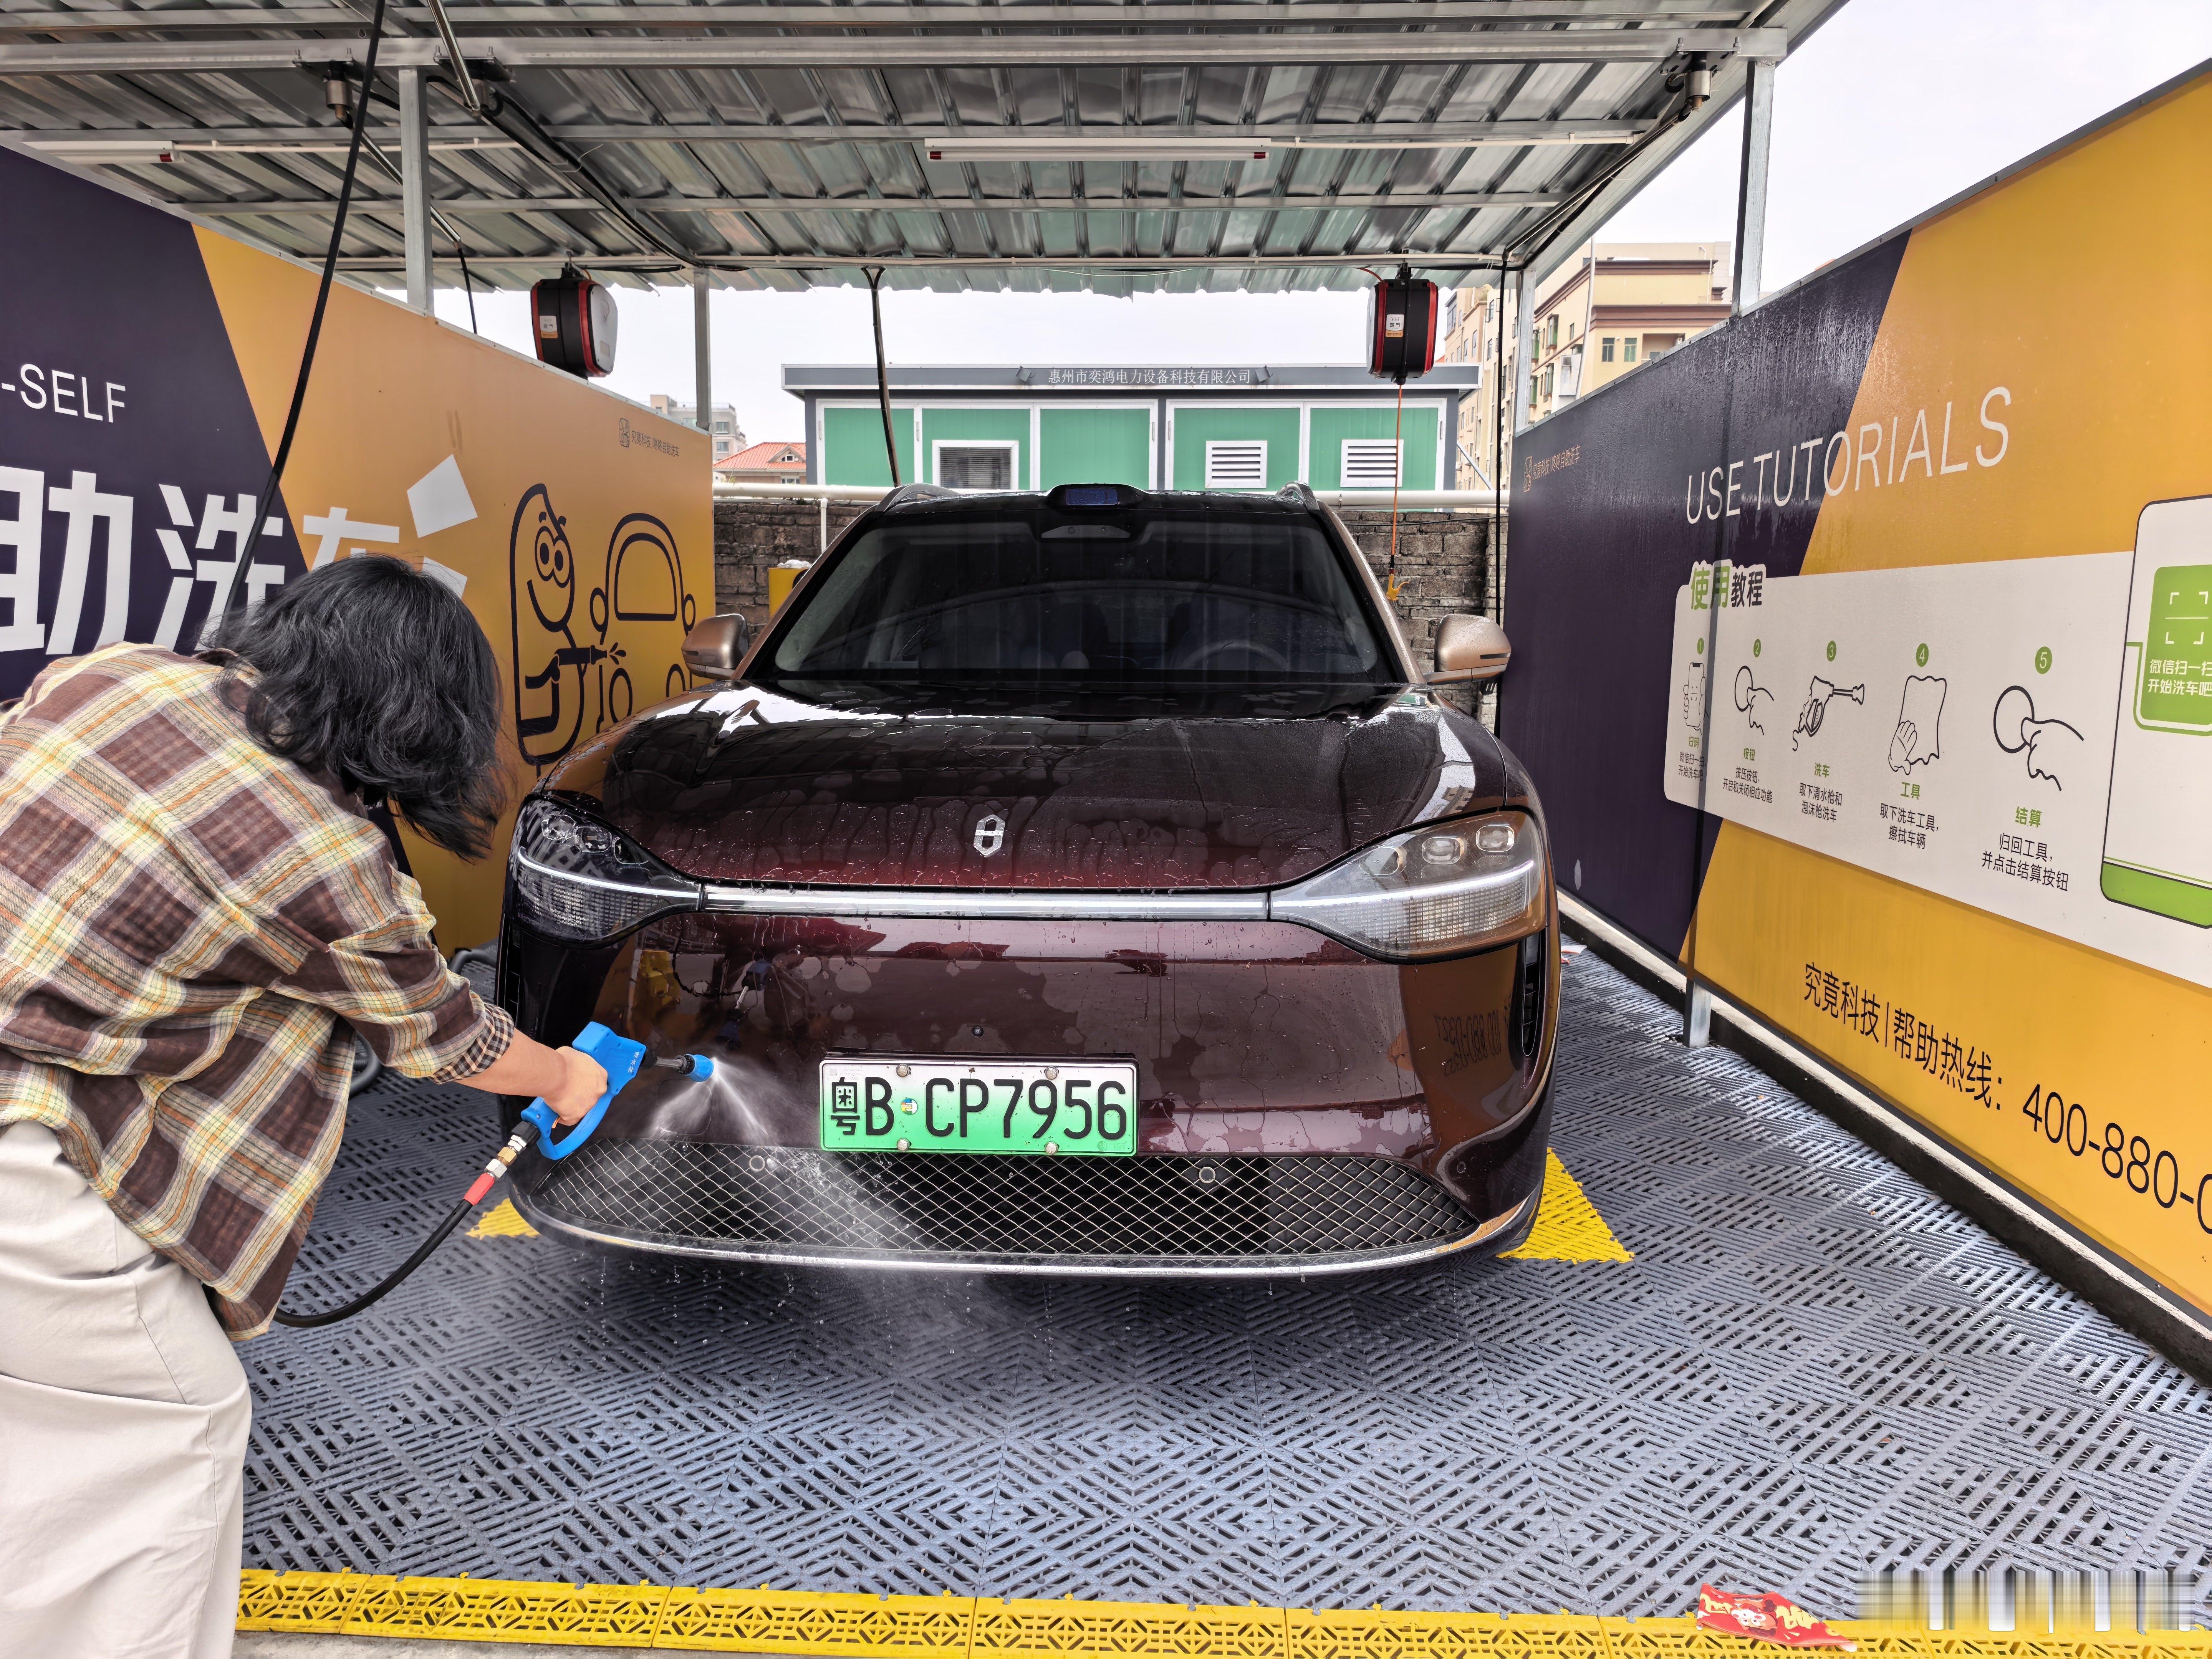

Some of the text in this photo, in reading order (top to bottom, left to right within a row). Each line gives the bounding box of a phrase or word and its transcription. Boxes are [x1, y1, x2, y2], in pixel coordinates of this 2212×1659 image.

[1048, 369, 1250, 384] 惠州市奕鸿电力设备科技有限公司
[2, 363, 126, 423] -SELF
[1687, 386, 2012, 524] USE TUTORIALS
[1691, 566, 1763, 610] 使用教程
[2150, 659, 2212, 676] 微信扫一扫
[2148, 679, 2212, 697] 开始洗车吧
[1688, 736, 1699, 748] 扫码
[1743, 747, 1755, 761] 按钮
[1814, 762, 1830, 778] 洗车
[1723, 778, 1773, 803] 开启和关闭相应功能
[1799, 782, 1843, 806] 取下清水枪和
[1900, 781, 1920, 800] 工具
[1801, 800, 1837, 823] 泡沫枪洗车
[2015, 806, 2042, 828] 结算
[1889, 825, 1927, 849] 擦拭车辆
[1982, 850, 2069, 891] 并点击结算按钮
[830, 1076, 1127, 1140] 粤B CP7956
